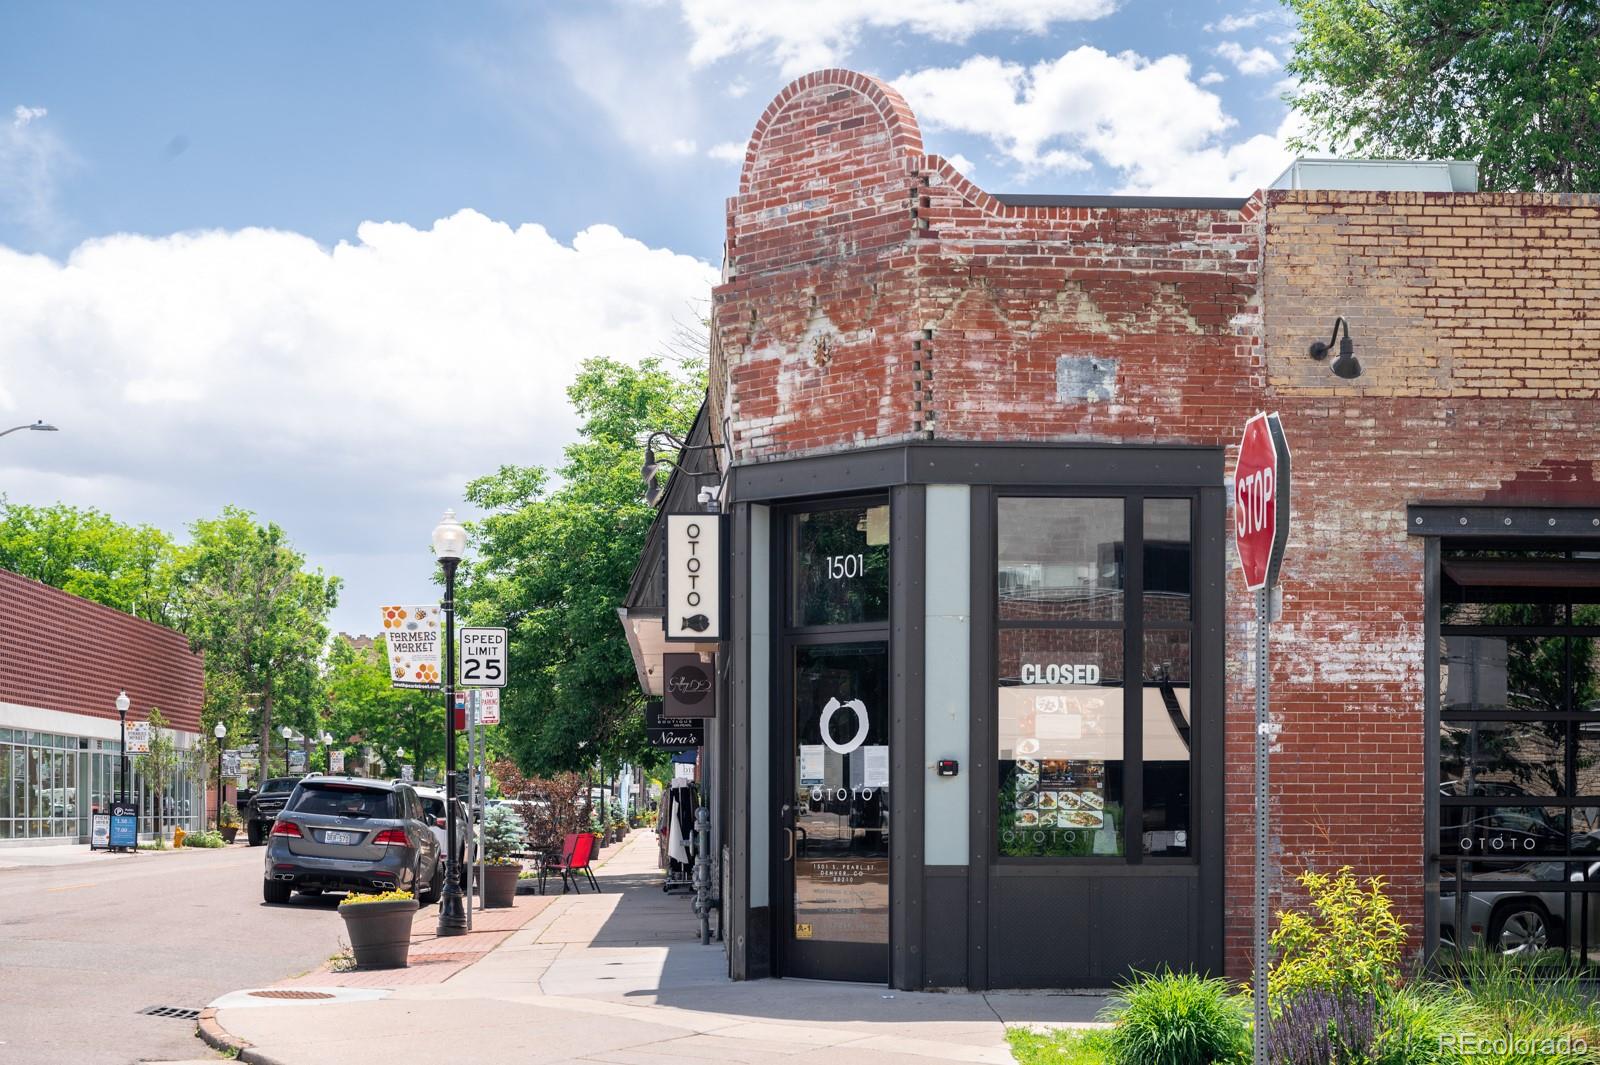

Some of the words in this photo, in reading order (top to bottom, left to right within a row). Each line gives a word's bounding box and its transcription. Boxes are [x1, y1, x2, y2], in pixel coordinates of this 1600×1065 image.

[1238, 467, 1273, 538] STOP
[686, 523, 701, 607] OTOTO
[826, 554, 864, 579] 1501
[390, 631, 437, 642] FARMERS
[464, 635, 503, 644] SPEED
[393, 642, 434, 652] MARKET
[468, 647, 498, 655] LIMIT
[464, 659, 502, 680] 25
[1021, 664, 1100, 684] CLOSED
[652, 731, 697, 744] Nora's
[812, 788, 872, 801] OTOTO
[1460, 837, 1536, 850] OTOTO
